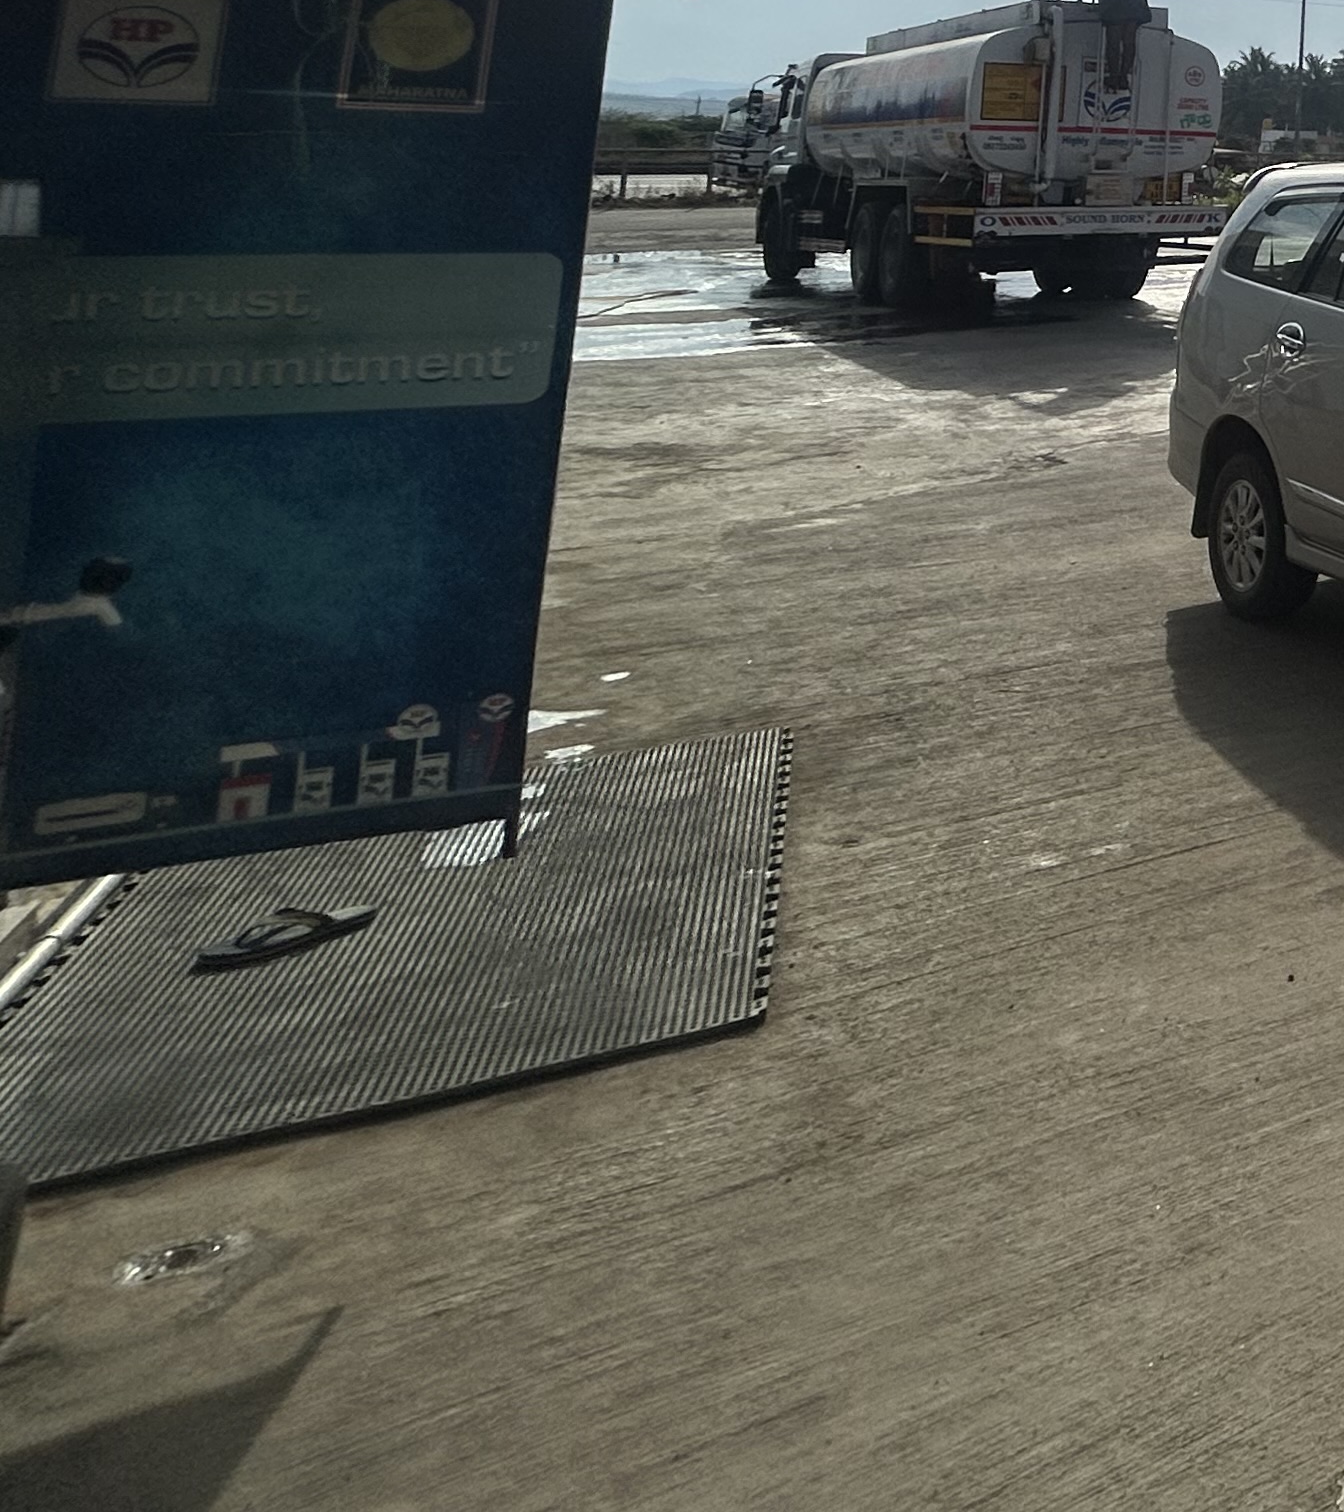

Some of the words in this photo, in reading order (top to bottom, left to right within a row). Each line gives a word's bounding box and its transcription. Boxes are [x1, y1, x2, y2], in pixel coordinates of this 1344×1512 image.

[110, 17, 175, 42] HP
[1065, 214, 1107, 225] SOUND
[1111, 213, 1146, 224] HORN
[140, 283, 323, 324] trust,
